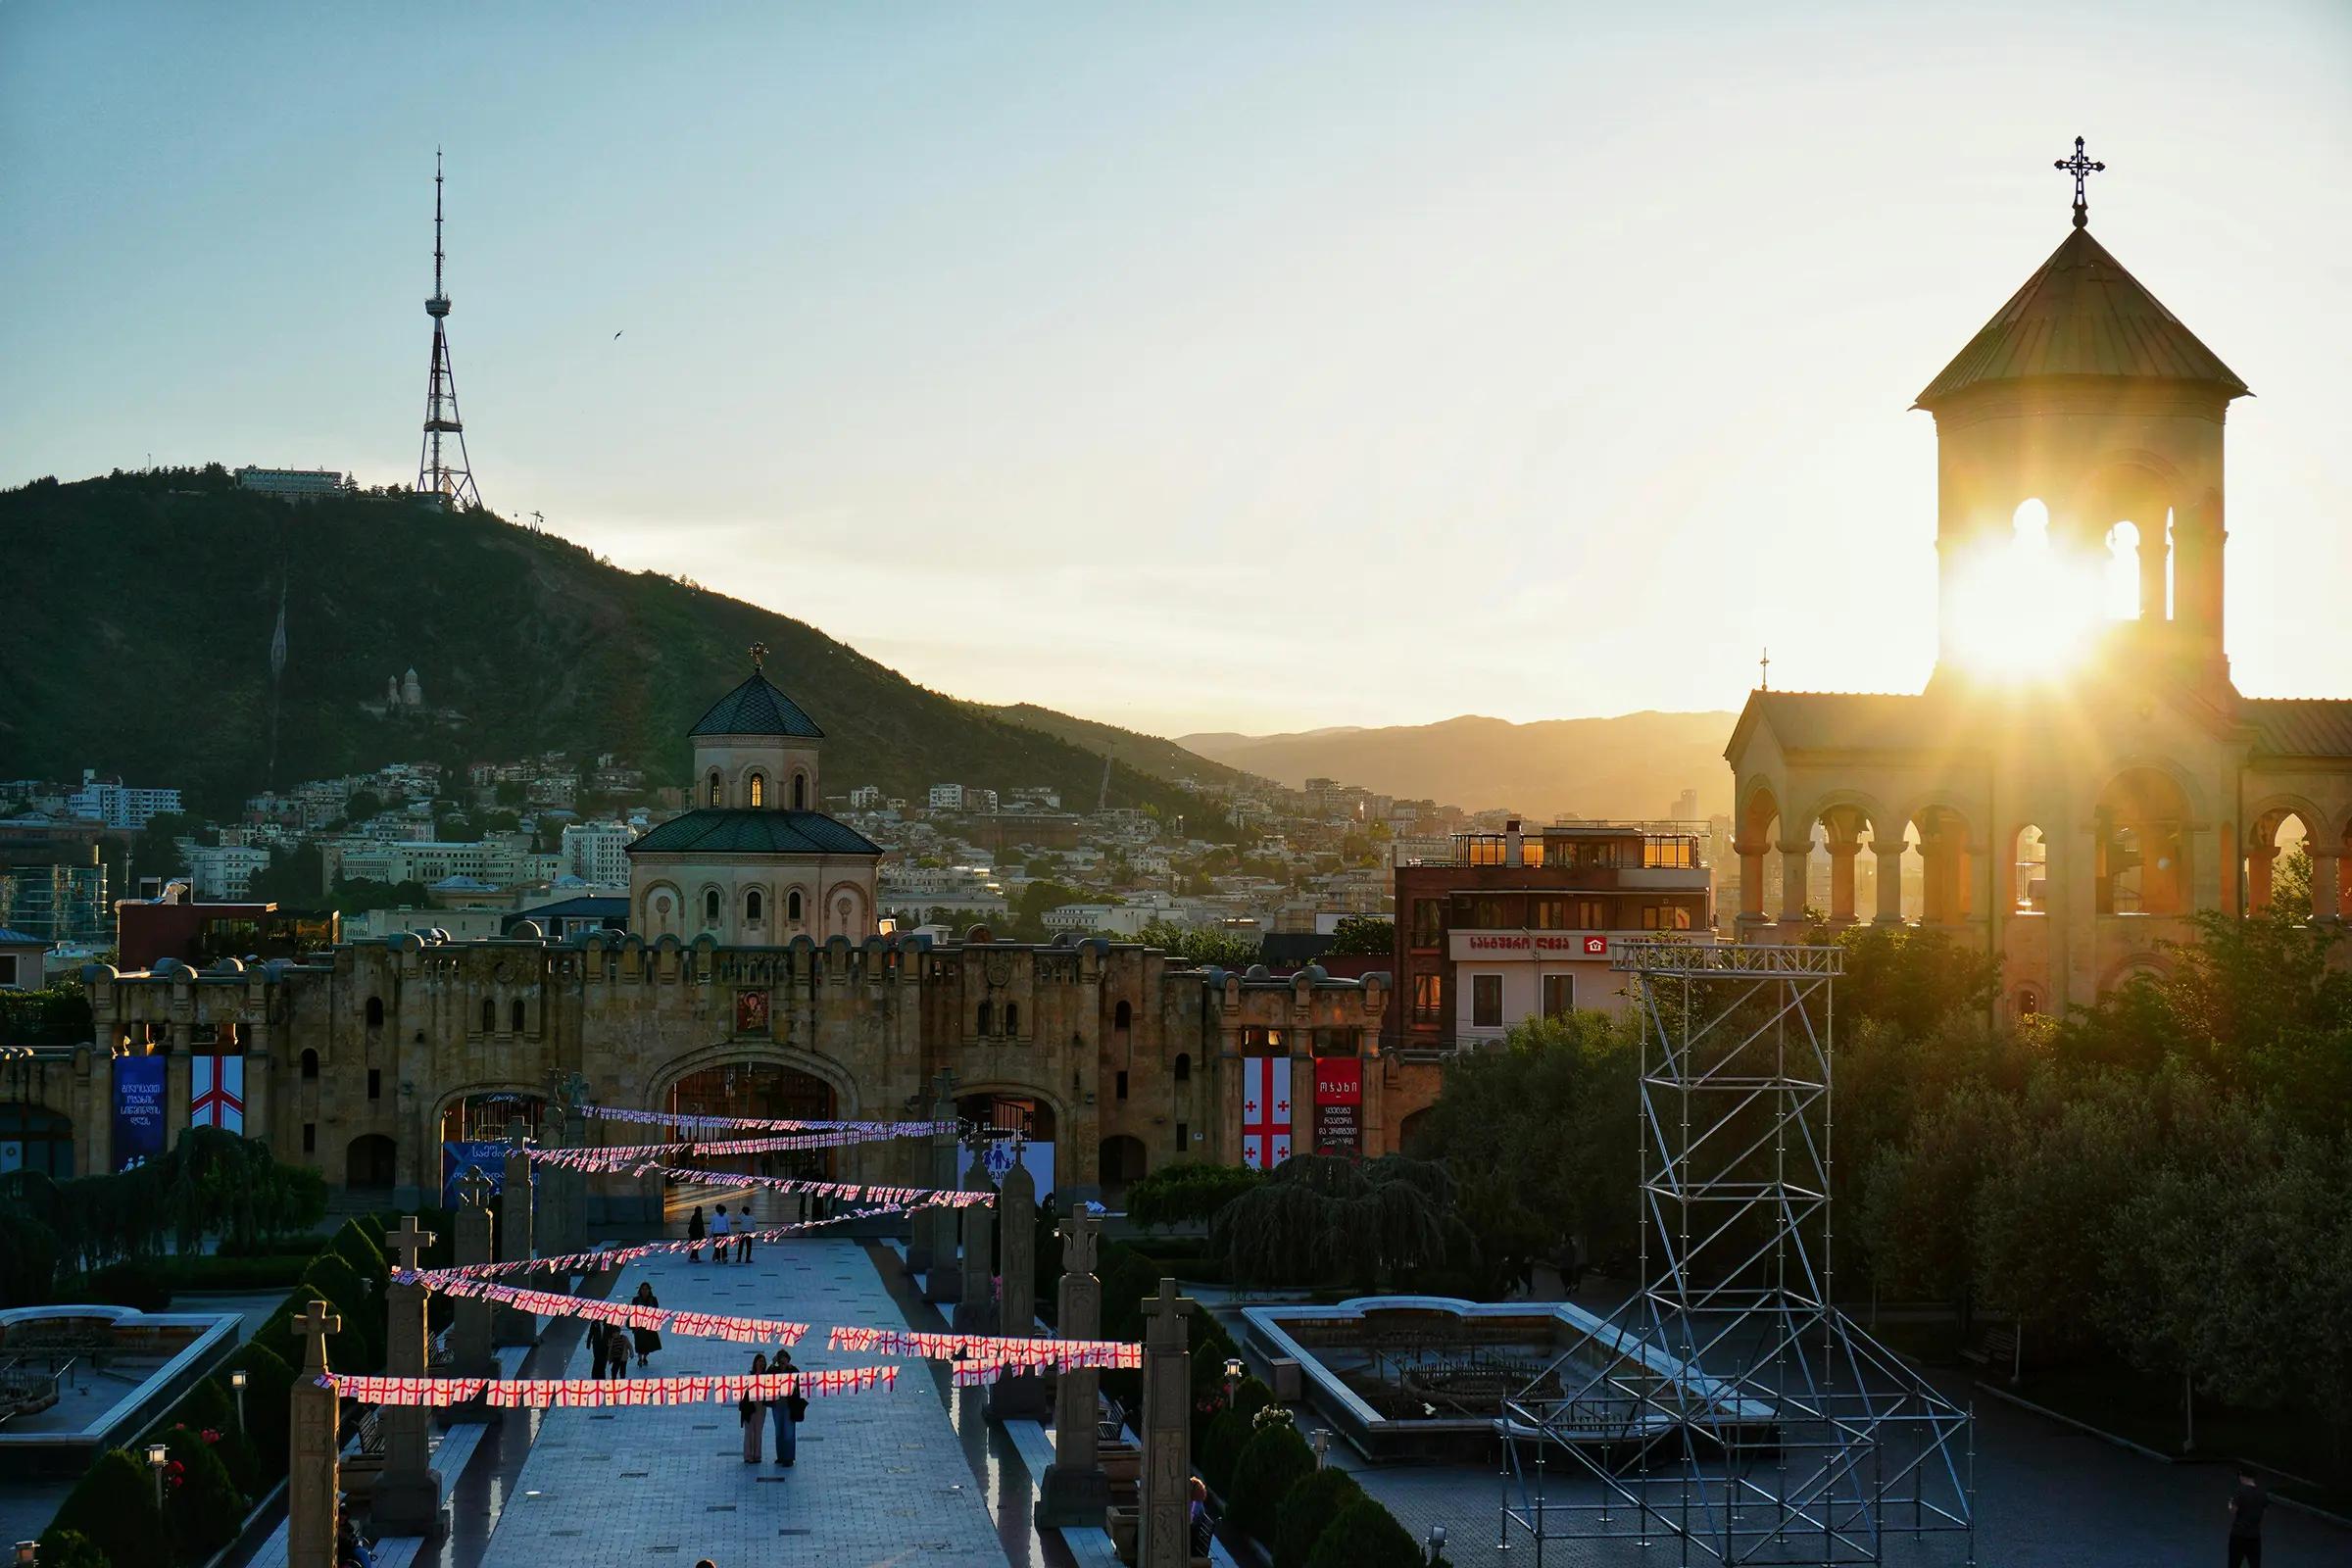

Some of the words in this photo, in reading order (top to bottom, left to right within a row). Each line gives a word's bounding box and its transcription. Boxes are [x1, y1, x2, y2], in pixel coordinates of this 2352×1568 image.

[1469, 937, 1531, 950] სასტუმრო
[1536, 937, 1570, 950] ლივა
[1319, 1081, 1357, 1093] ოჯახი
